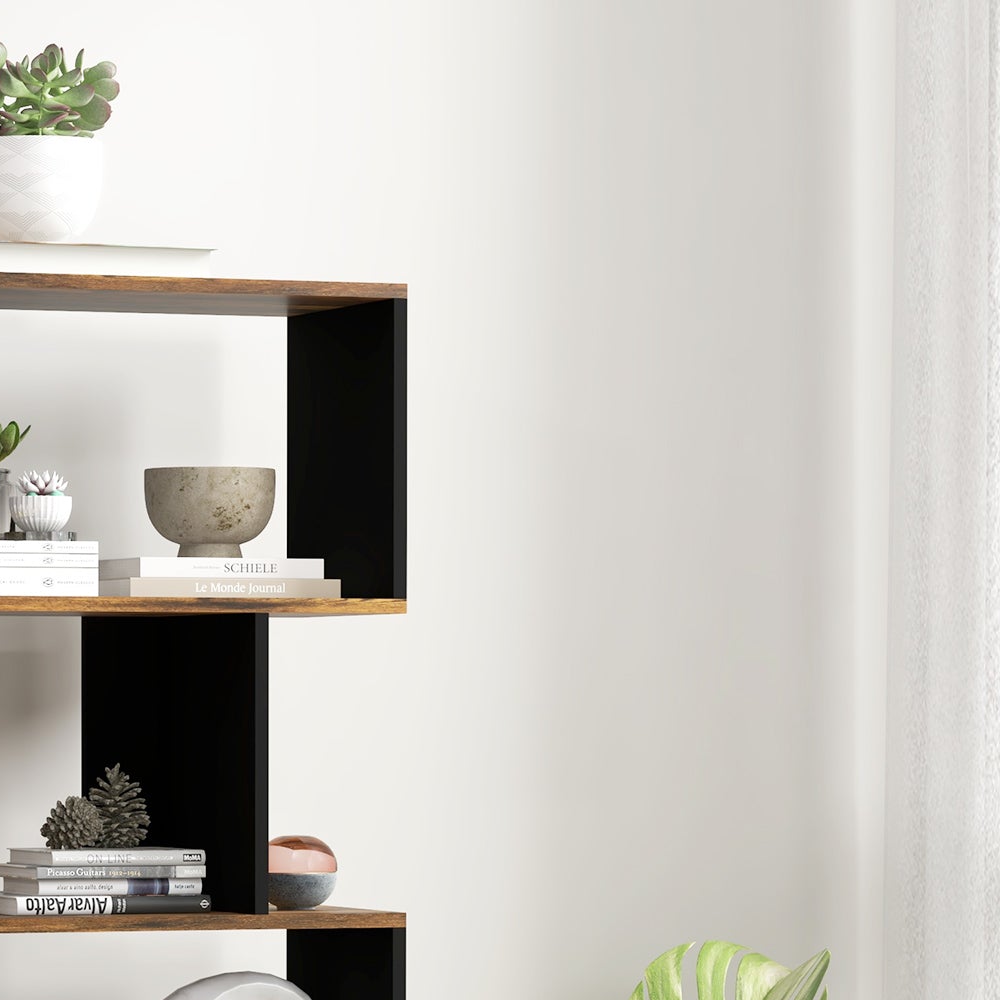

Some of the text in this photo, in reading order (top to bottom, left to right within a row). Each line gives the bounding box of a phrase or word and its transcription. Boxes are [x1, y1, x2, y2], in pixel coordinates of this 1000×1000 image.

[224, 562, 278, 574] SCHIELE
[195, 582, 286, 594] Le Monde Journal
[87, 854, 104, 864] ON
[107, 854, 132, 864] LINE
[47, 868, 75, 877] Picasso
[76, 868, 106, 877] Guitars
